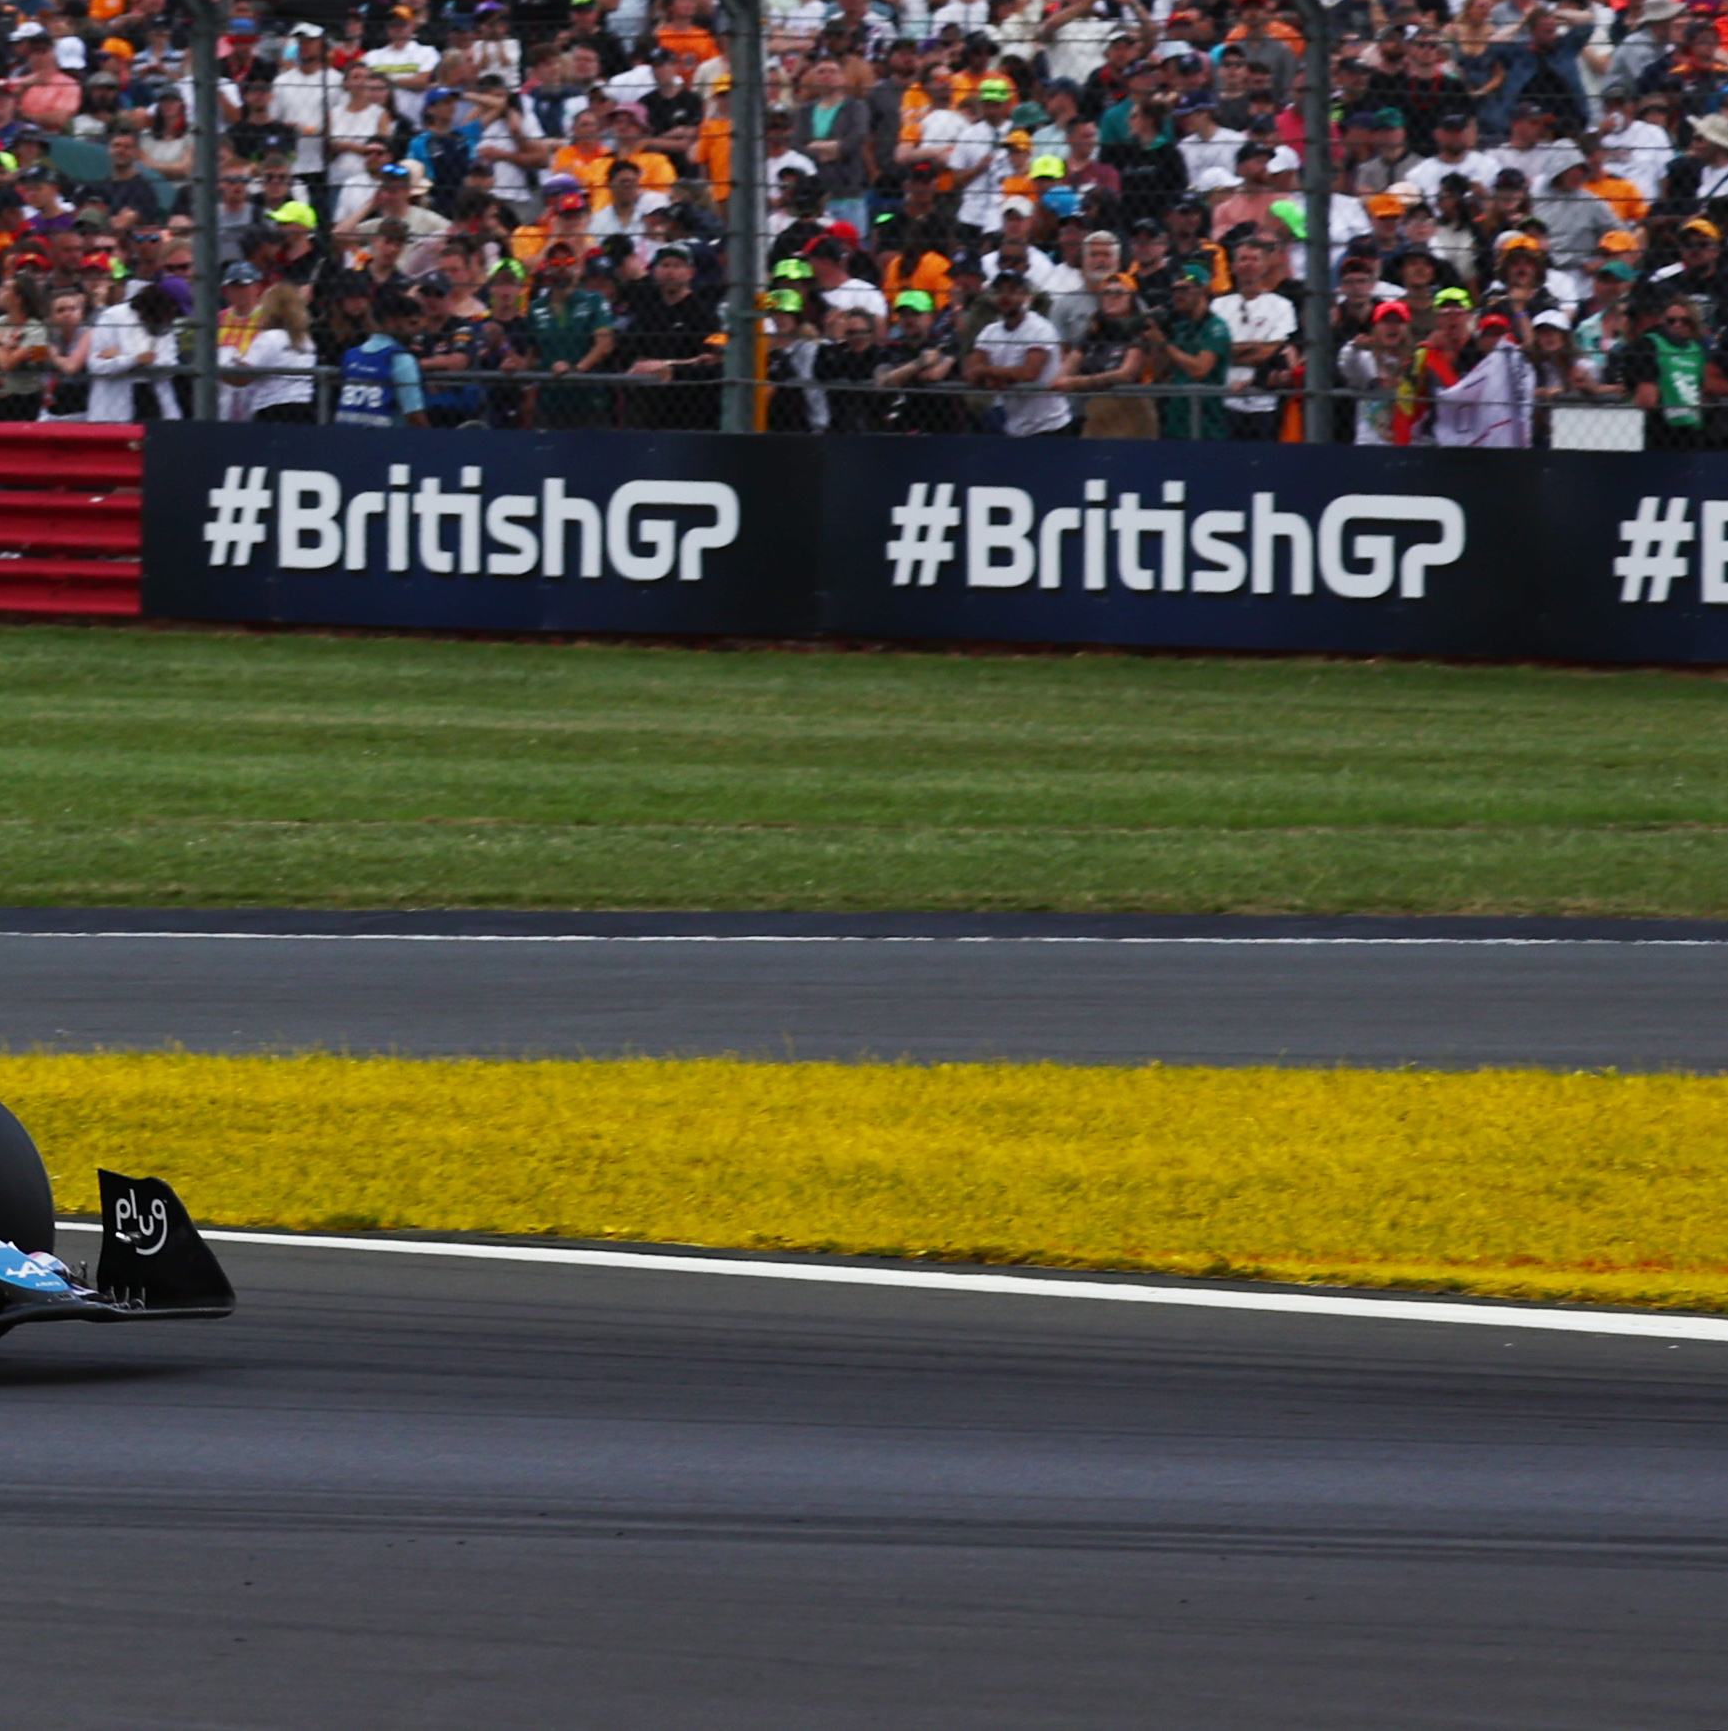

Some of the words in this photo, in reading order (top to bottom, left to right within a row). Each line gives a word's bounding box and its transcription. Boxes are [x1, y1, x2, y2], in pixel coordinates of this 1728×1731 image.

[201, 463, 741, 584] #BritishGP
[885, 478, 1468, 600] #BritishGP
[115, 1188, 169, 1256] plug
